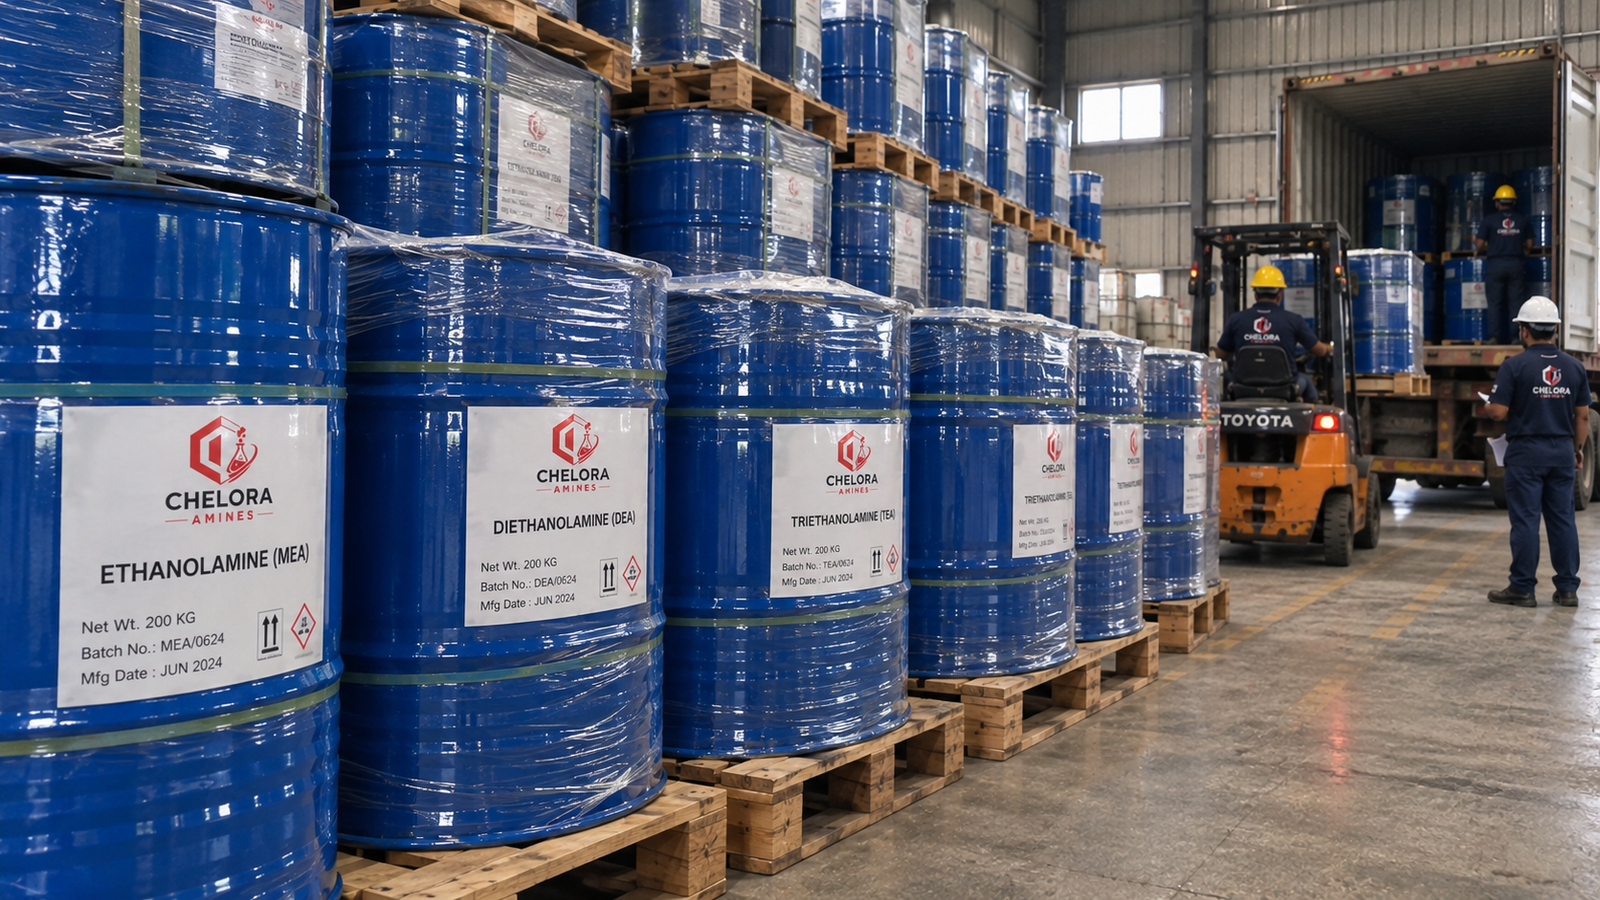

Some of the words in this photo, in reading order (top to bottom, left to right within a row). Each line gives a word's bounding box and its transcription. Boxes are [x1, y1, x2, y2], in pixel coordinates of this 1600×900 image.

[1243, 333, 1280, 341] CHELORA
[1532, 386, 1571, 395] CHELORA
[1222, 414, 1293, 428] TOYOTA
[537, 467, 610, 483] CHELORA
[826, 473, 878, 486] CHELORA
[554, 483, 597, 493] AMINES
[839, 486, 869, 495] AMINES
[165, 487, 273, 511] CHELORA
[191, 510, 254, 525] AMINES
[494, 513, 609, 535] DIETHANOLAMINE
[611, 510, 636, 527] (DEA)
[791, 511, 878, 527] TRIETHANOLAMINE
[880, 508, 895, 522] (TEA)
[783, 548, 797, 556] Net
[799, 547, 813, 555] Wt.
[815, 546, 829, 554] 200
[830, 544, 840, 553] KG
[101, 549, 268, 584] ETHANOLAMINE
[273, 543, 309, 568] (MEA)
[480, 562, 500, 572] Net
[502, 561, 520, 571] Wt.
[523, 559, 542, 570] 200
[544, 557, 558, 567] KG
[782, 563, 803, 571] Batch
[480, 581, 509, 592] Batch
[534, 574, 576, 588] DEA/0624
[782, 577, 798, 587] Mfg
[799, 576, 817, 585] Date
[822, 575, 836, 584] JUN
[480, 600, 501, 612] Mfg
[503, 599, 526, 609] Date
[534, 595, 553, 606] JUN
[555, 593, 575, 604] 2024
[81, 621, 109, 634] Net
[114, 618, 140, 632] Wt.
[145, 614, 172, 629] 200
[176, 611, 196, 625] KG
[81, 645, 123, 660] Batch
[160, 632, 225, 652] MEA/0624
[81, 671, 110, 687] Mfg
[115, 668, 148, 682] Date
[160, 662, 188, 677] JUN
[192, 656, 223, 672] 2024
